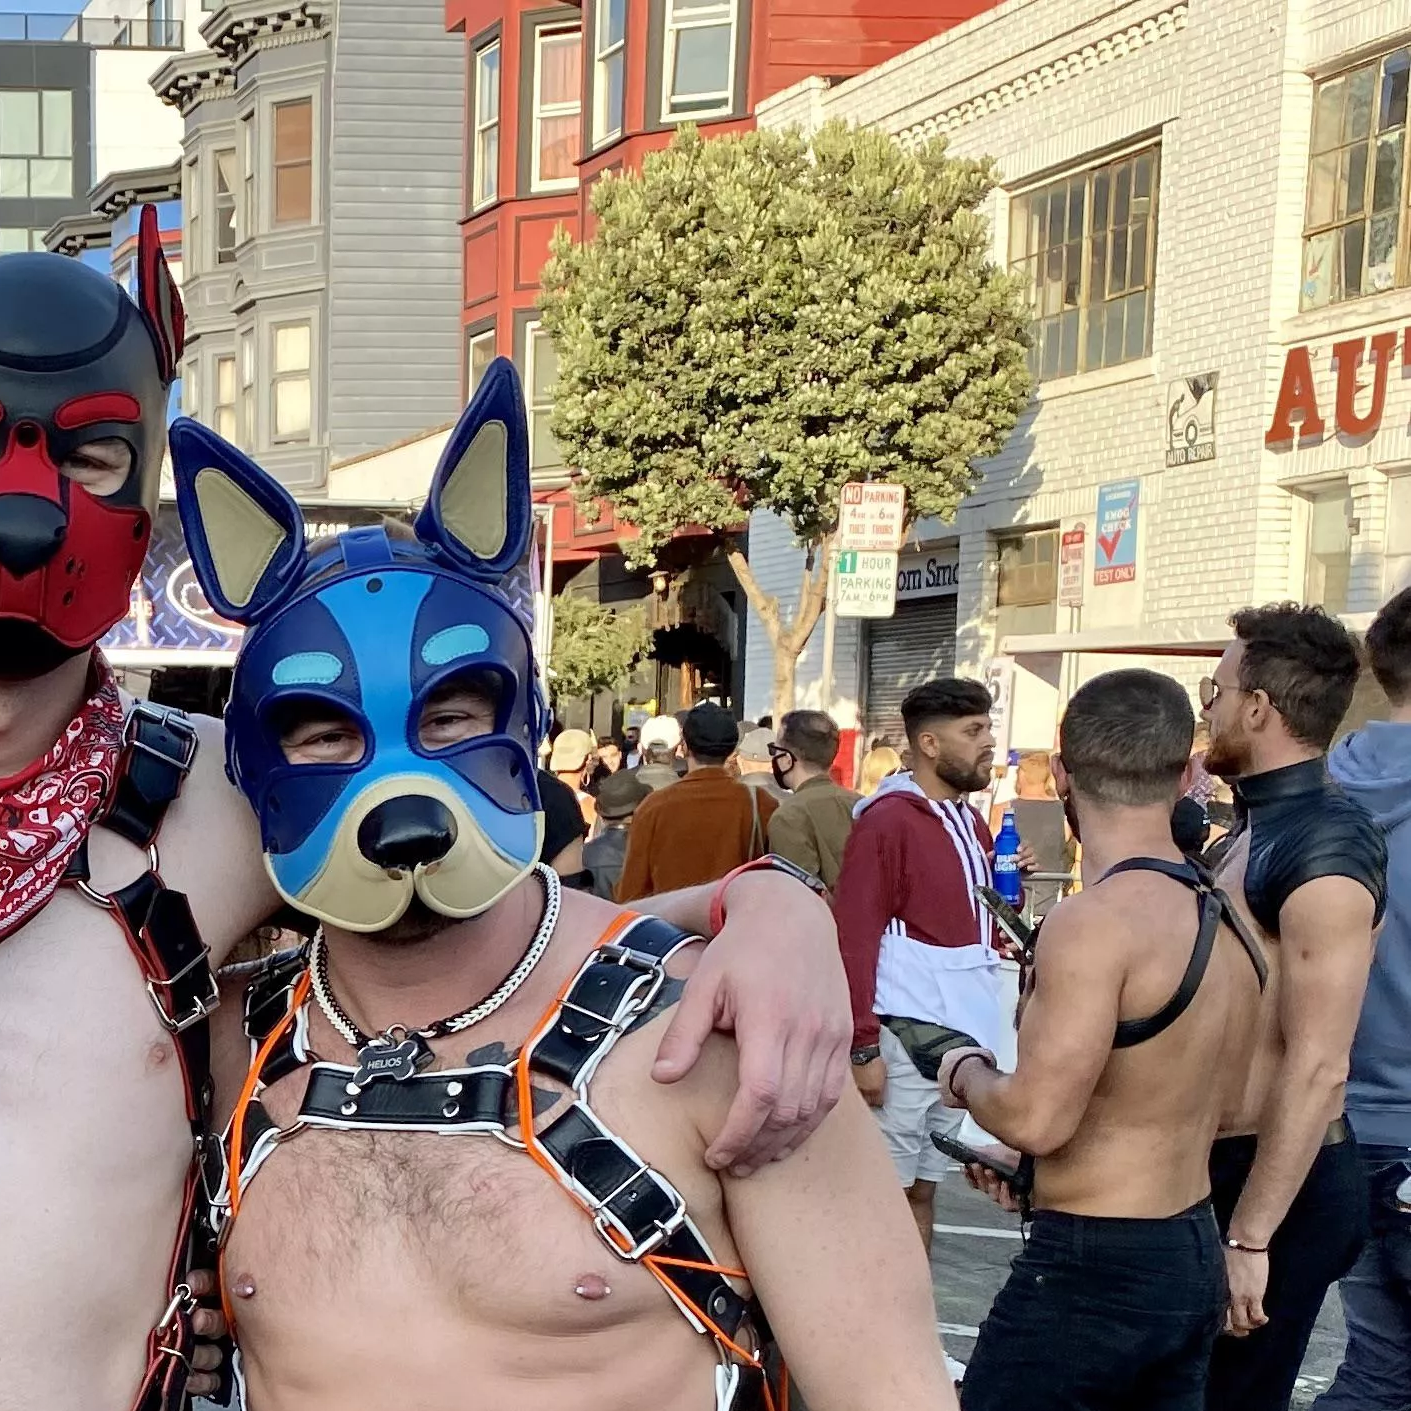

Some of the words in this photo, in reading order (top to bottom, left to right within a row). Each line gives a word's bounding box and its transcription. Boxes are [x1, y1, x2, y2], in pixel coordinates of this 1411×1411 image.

[1265, 327, 1411, 445] AU
[1167, 448, 1186, 465] AUTO
[1188, 444, 1214, 461] REPAIR
[846, 485, 861, 503] NO
[864, 491, 899, 503] PARKING
[1105, 507, 1130, 520] SMOG
[1101, 520, 1132, 533] CHECK
[845, 554, 852, 570] 1
[862, 557, 891, 570] HOUR
[1095, 569, 1114, 581] TEST
[1115, 567, 1135, 579] ONLY
[840, 578, 892, 590] PARKING
[367, 1056, 403, 1070] HELIOS
